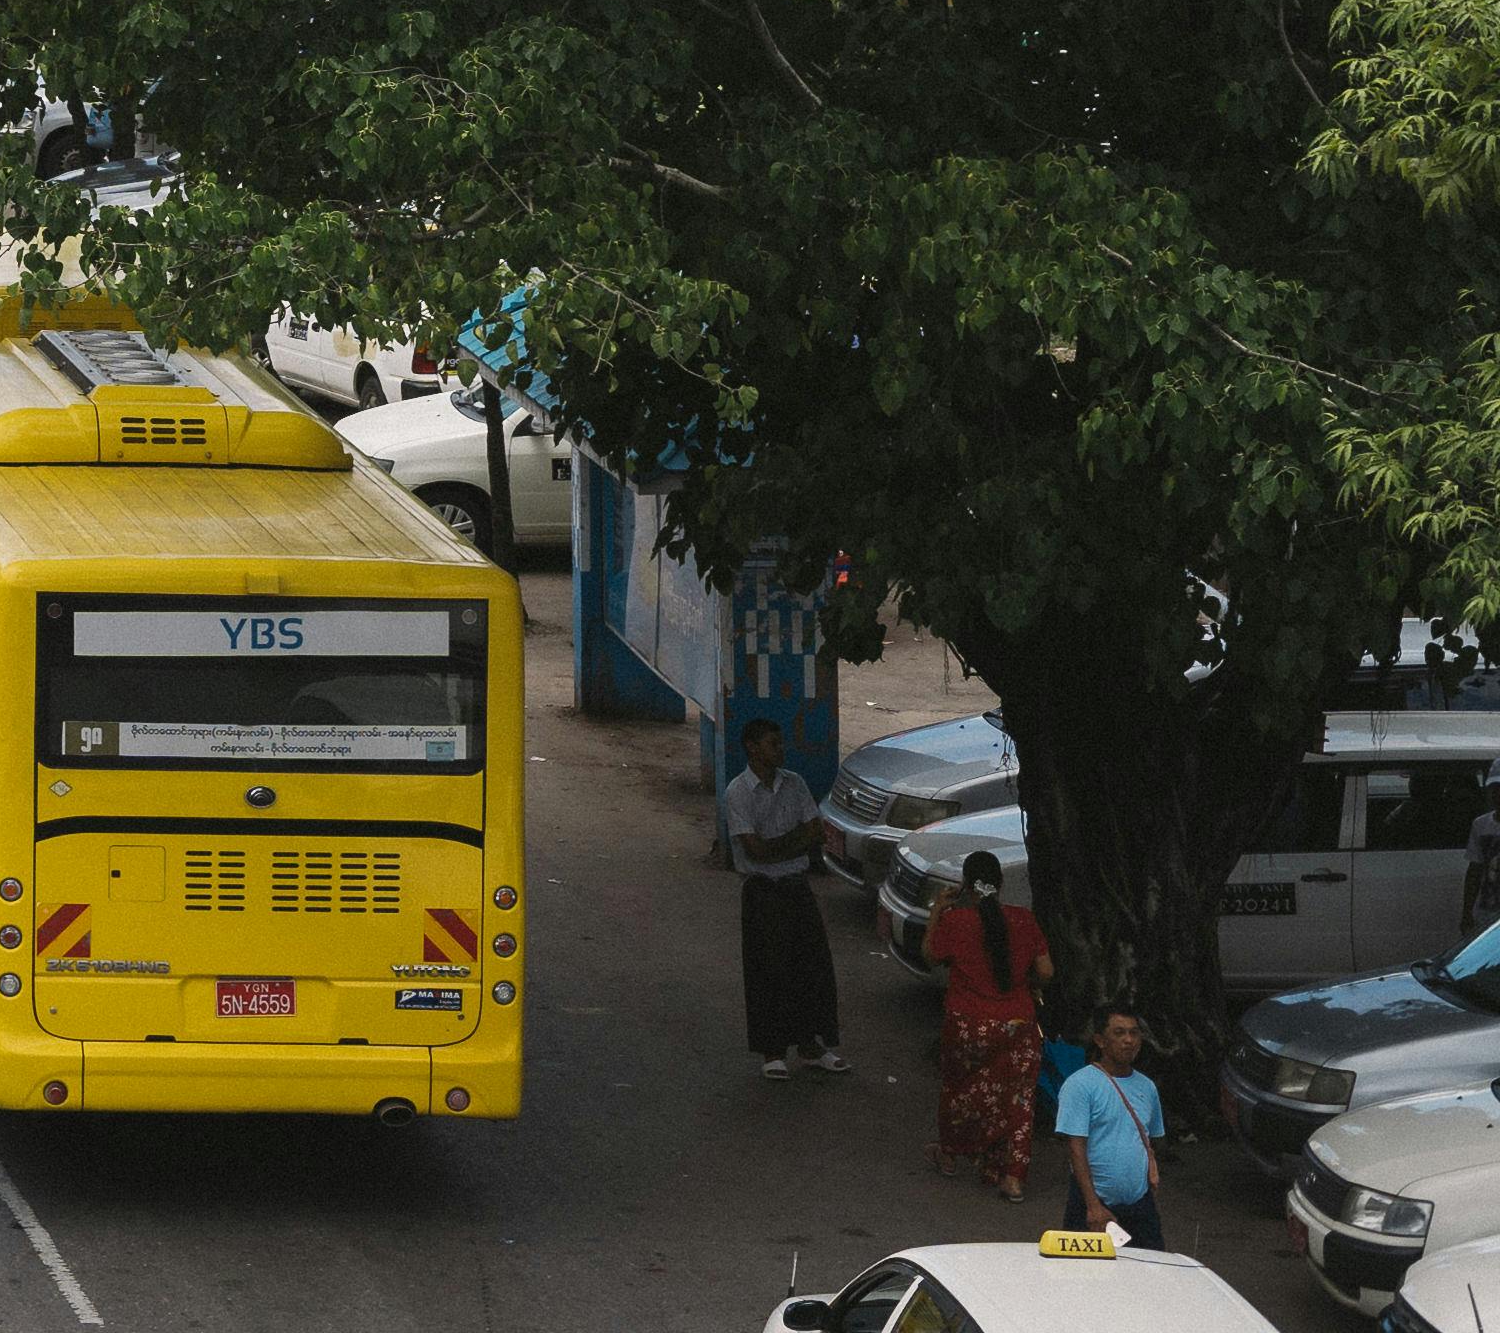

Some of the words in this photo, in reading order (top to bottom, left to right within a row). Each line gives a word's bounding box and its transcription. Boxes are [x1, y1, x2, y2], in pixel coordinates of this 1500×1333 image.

[220, 617, 304, 650] YBS
[391, 964, 471, 978] YUTONG
[243, 983, 269, 993] YGN
[221, 994, 290, 1015] 5N-4559
[1057, 1237, 1103, 1253] TAXI
